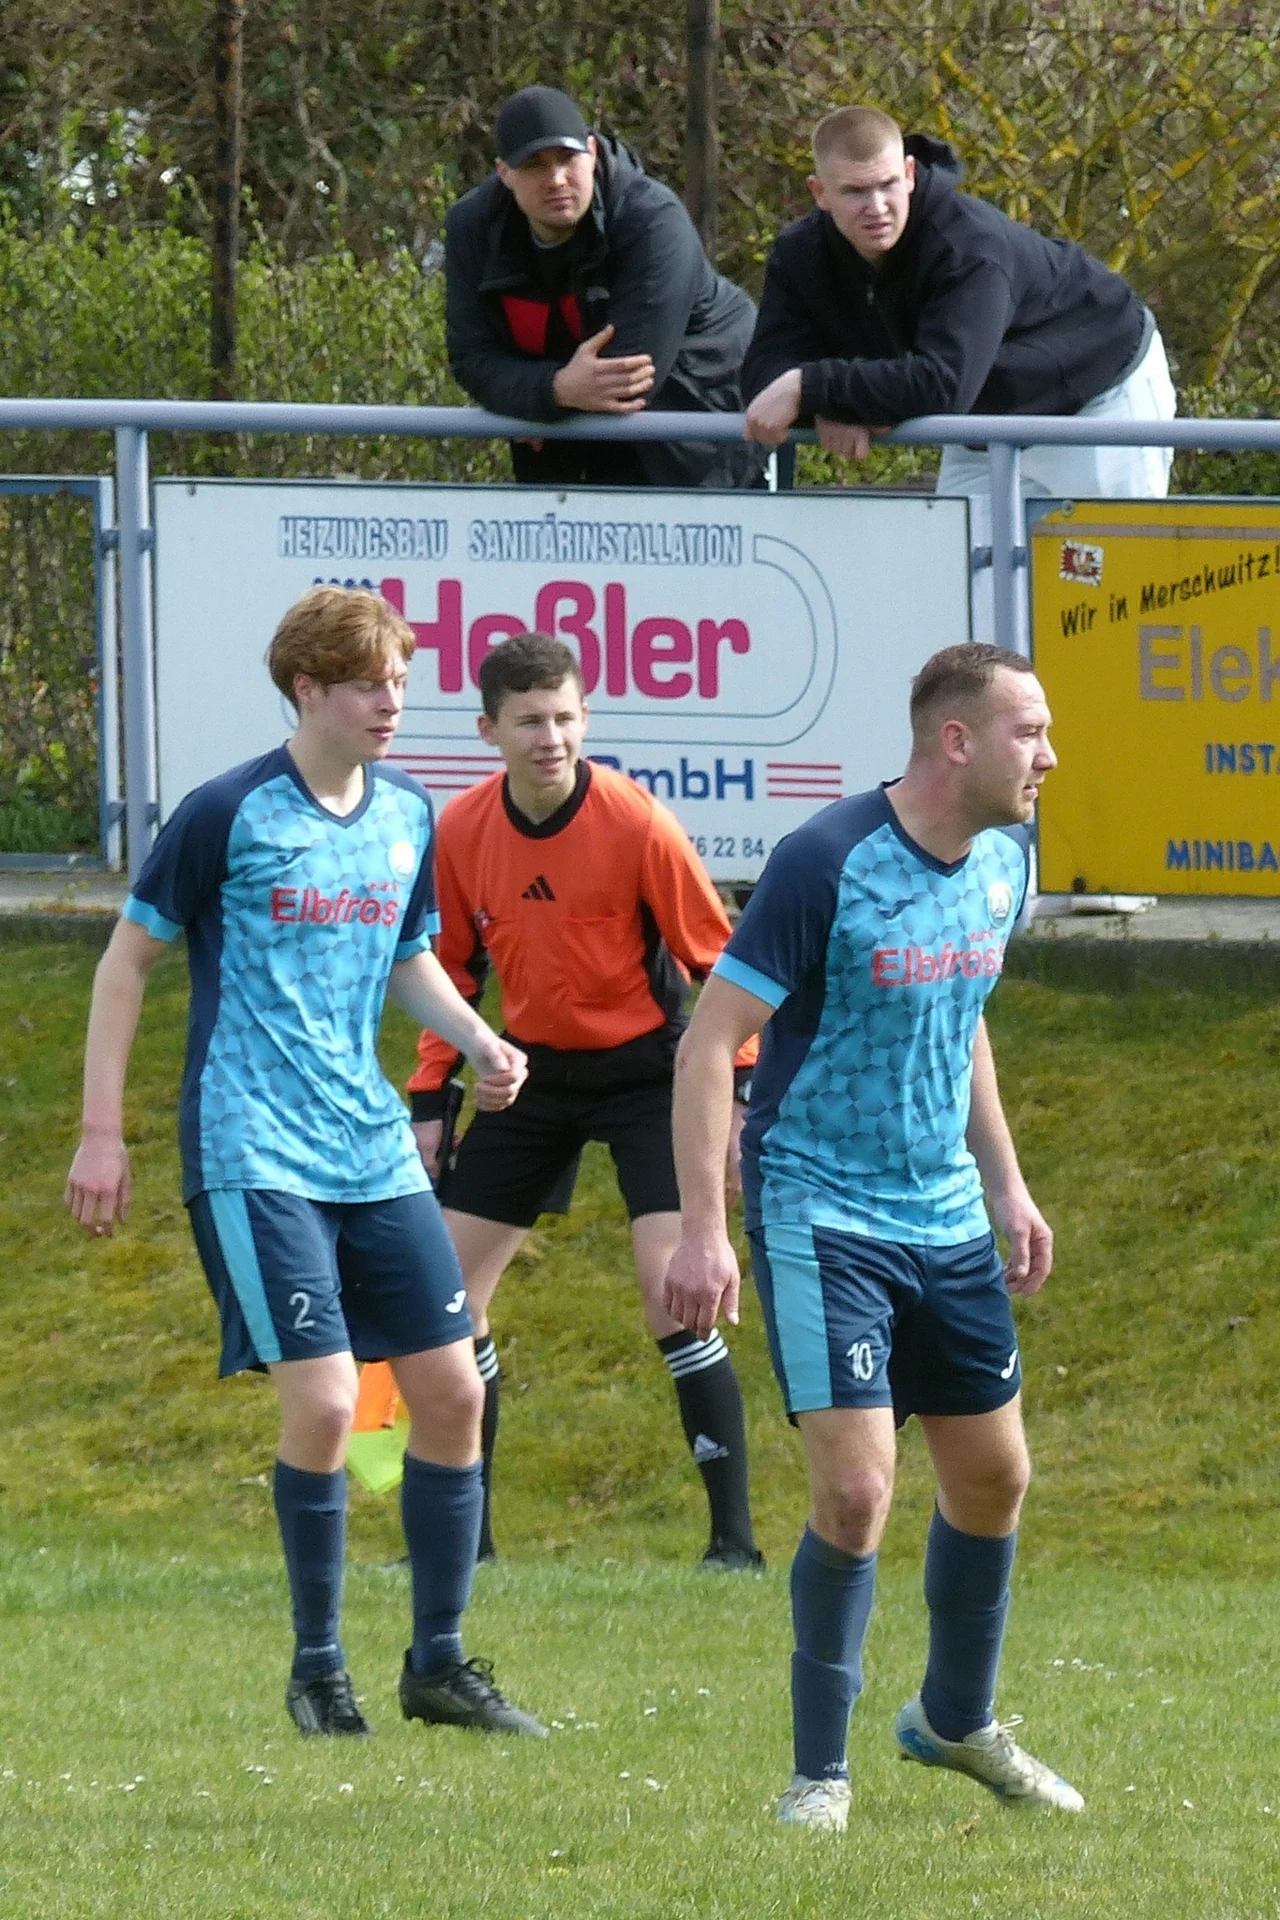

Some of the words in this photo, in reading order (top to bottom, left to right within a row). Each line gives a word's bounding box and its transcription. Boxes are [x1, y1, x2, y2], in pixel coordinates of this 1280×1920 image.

[279, 514, 449, 560] HEIZUNGSBAU
[467, 513, 743, 565] SANITÄRINSTALLATION
[1060, 602, 1098, 638] Wir
[1109, 594, 1128, 624] in
[1204, 743, 1280, 775] INST
[713, 836, 736, 857] 22
[742, 837, 764, 858] 84
[288, 1291, 316, 1330] 2
[847, 1342, 873, 1380] 10
